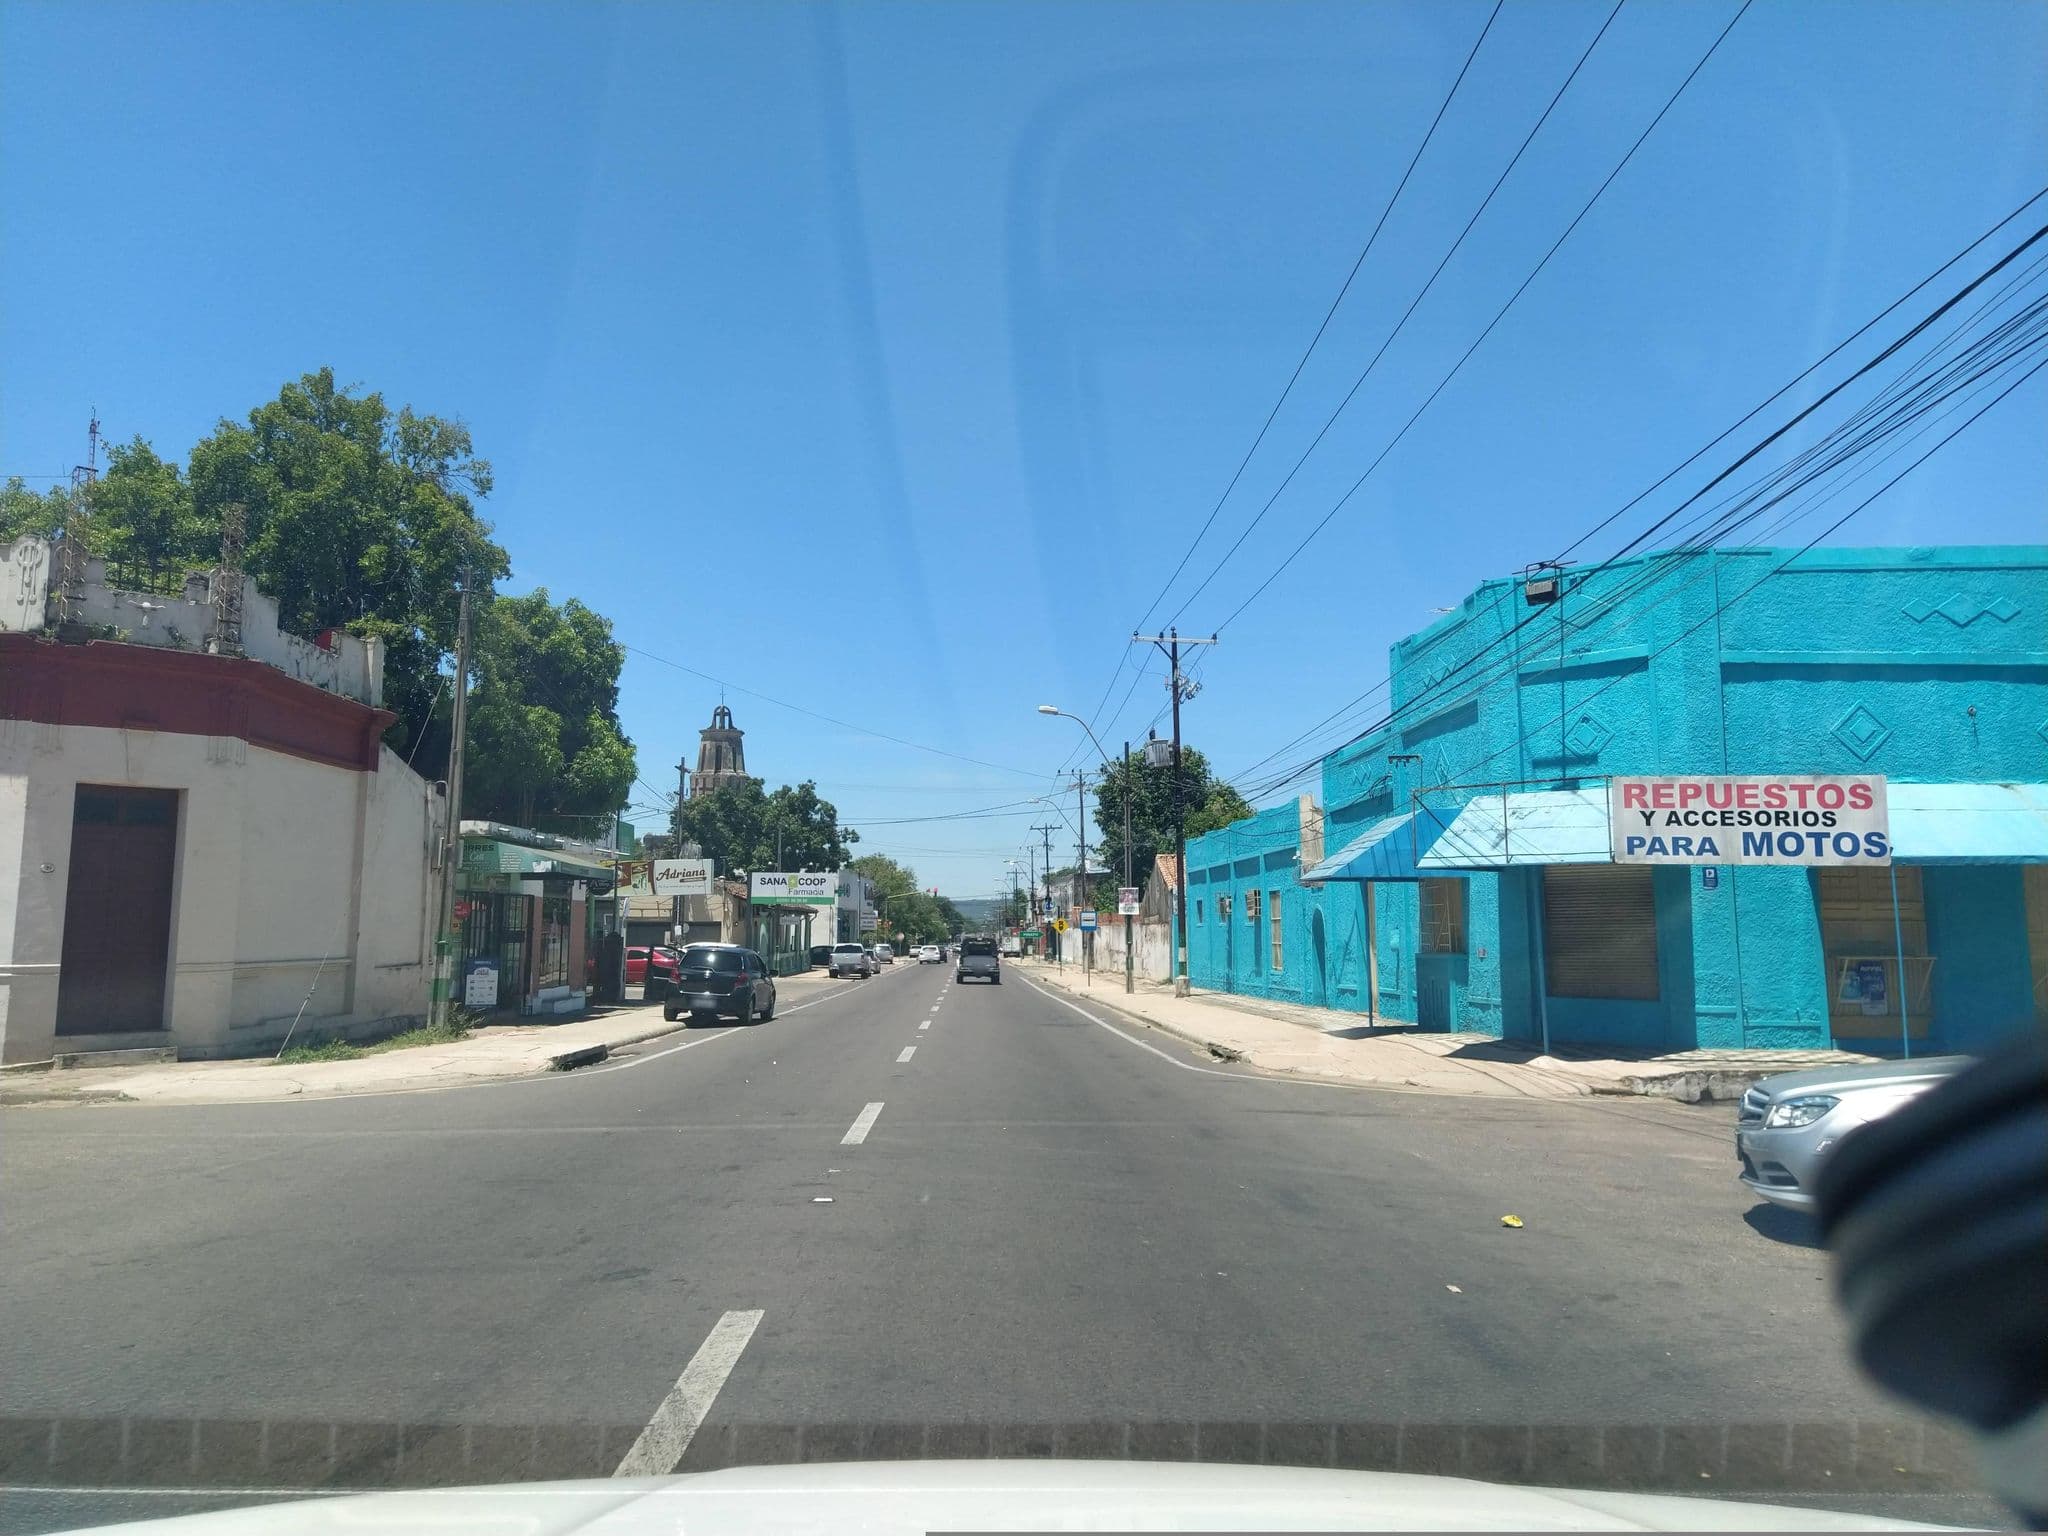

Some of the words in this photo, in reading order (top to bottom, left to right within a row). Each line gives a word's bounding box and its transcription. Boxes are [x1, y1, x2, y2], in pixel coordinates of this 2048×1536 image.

[1623, 783, 1874, 810] REPUESTOS
[1640, 810, 1656, 827] Y
[1665, 810, 1837, 827] ACCESORIOS
[1626, 836, 1720, 856] PARA
[1742, 831, 1889, 858] MOTOS
[656, 868, 705, 881] Adriana
[760, 877, 788, 886] SANA
[798, 878, 826, 886] COOP
